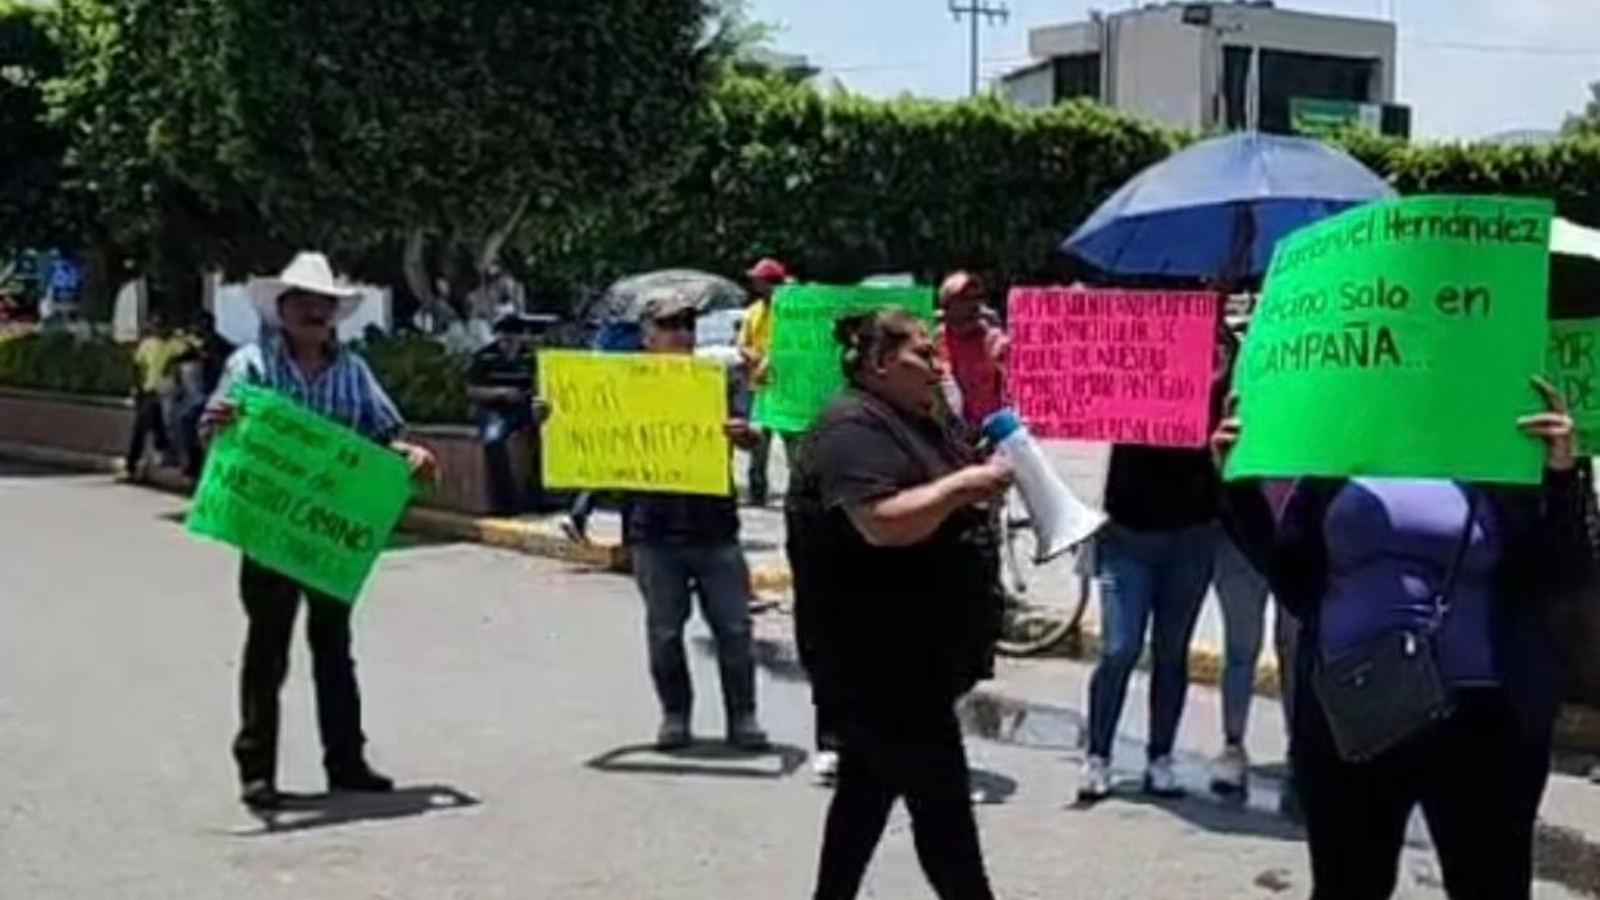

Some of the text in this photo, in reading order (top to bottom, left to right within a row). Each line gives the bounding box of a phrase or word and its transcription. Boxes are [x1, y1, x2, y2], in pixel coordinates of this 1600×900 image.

[1384, 206, 1541, 245] Hernández
[1338, 276, 1408, 312] Solo
[1435, 284, 1490, 318] en
